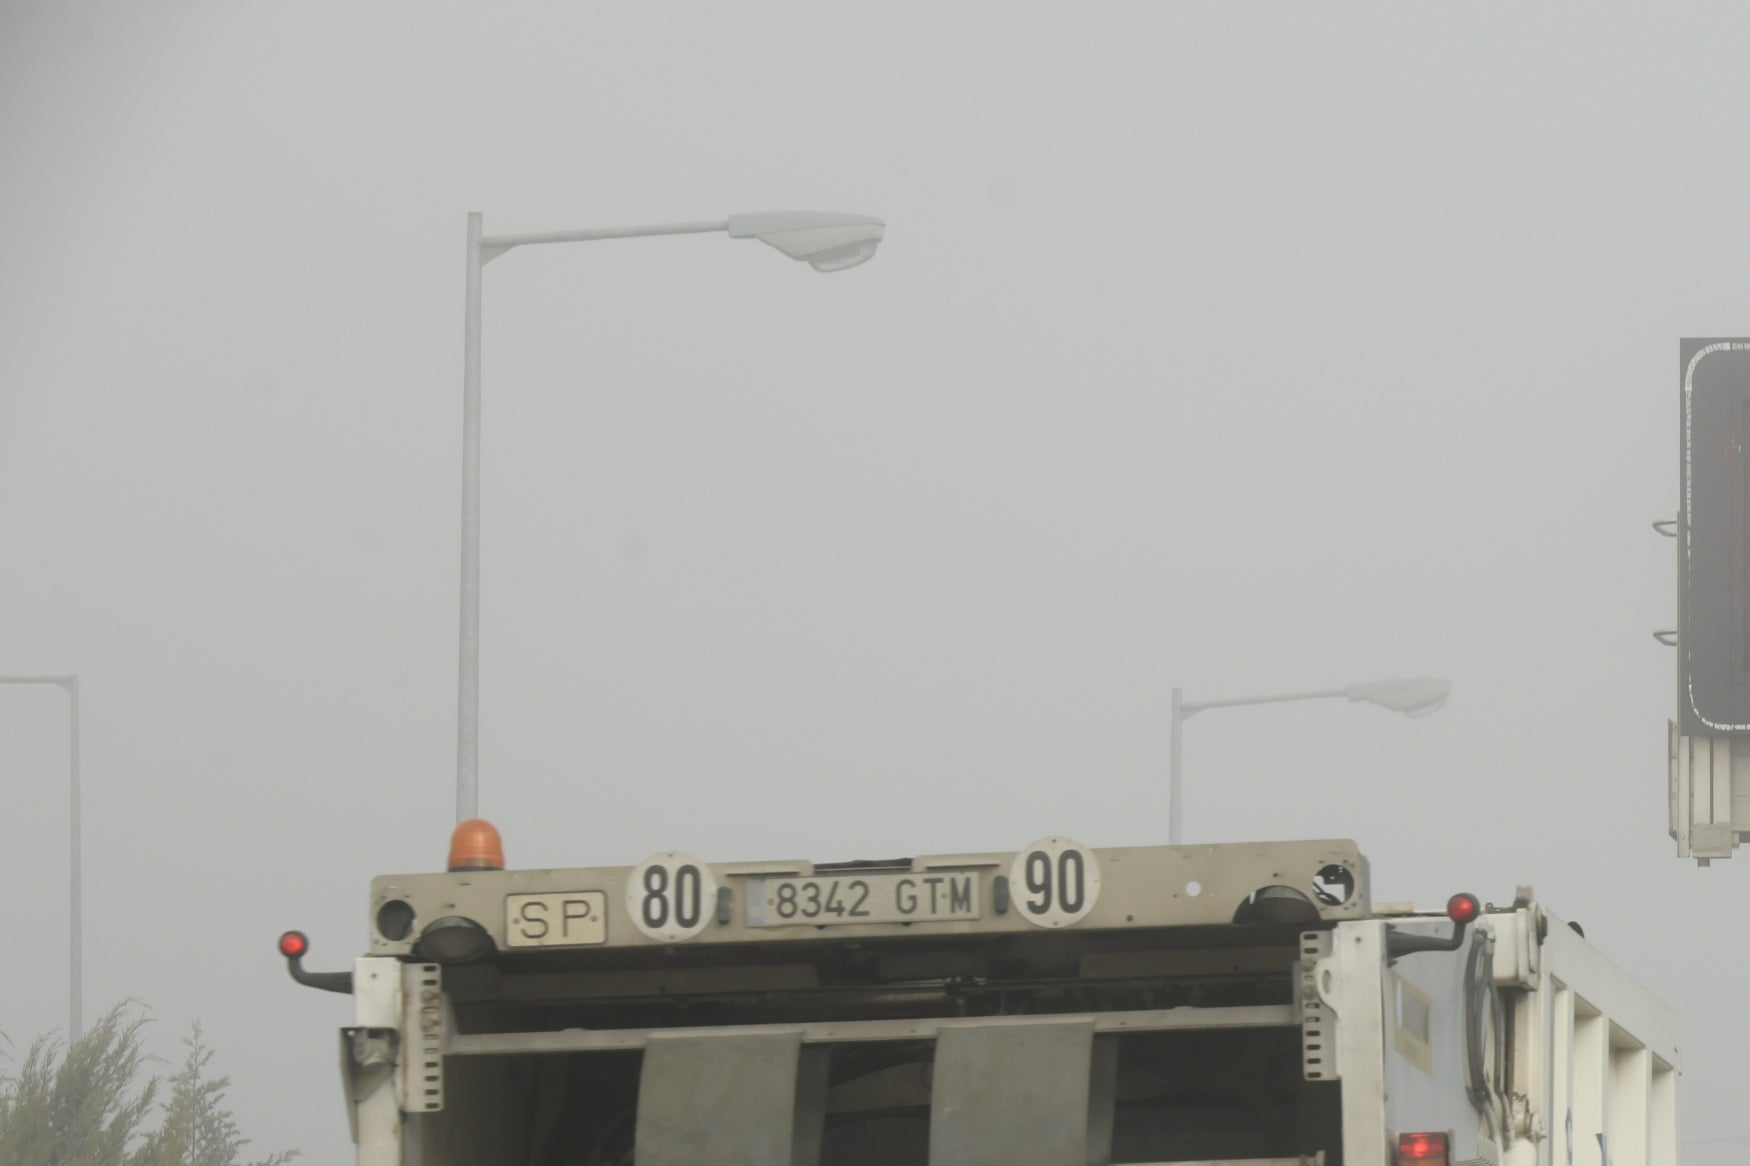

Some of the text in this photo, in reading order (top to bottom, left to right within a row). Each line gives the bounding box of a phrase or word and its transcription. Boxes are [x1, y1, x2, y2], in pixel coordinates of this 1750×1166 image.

[642, 864, 701, 929] 80
[776, 876, 972, 919] 8342 GTM
[1025, 849, 1085, 915] 90
[520, 899, 591, 939] SP
